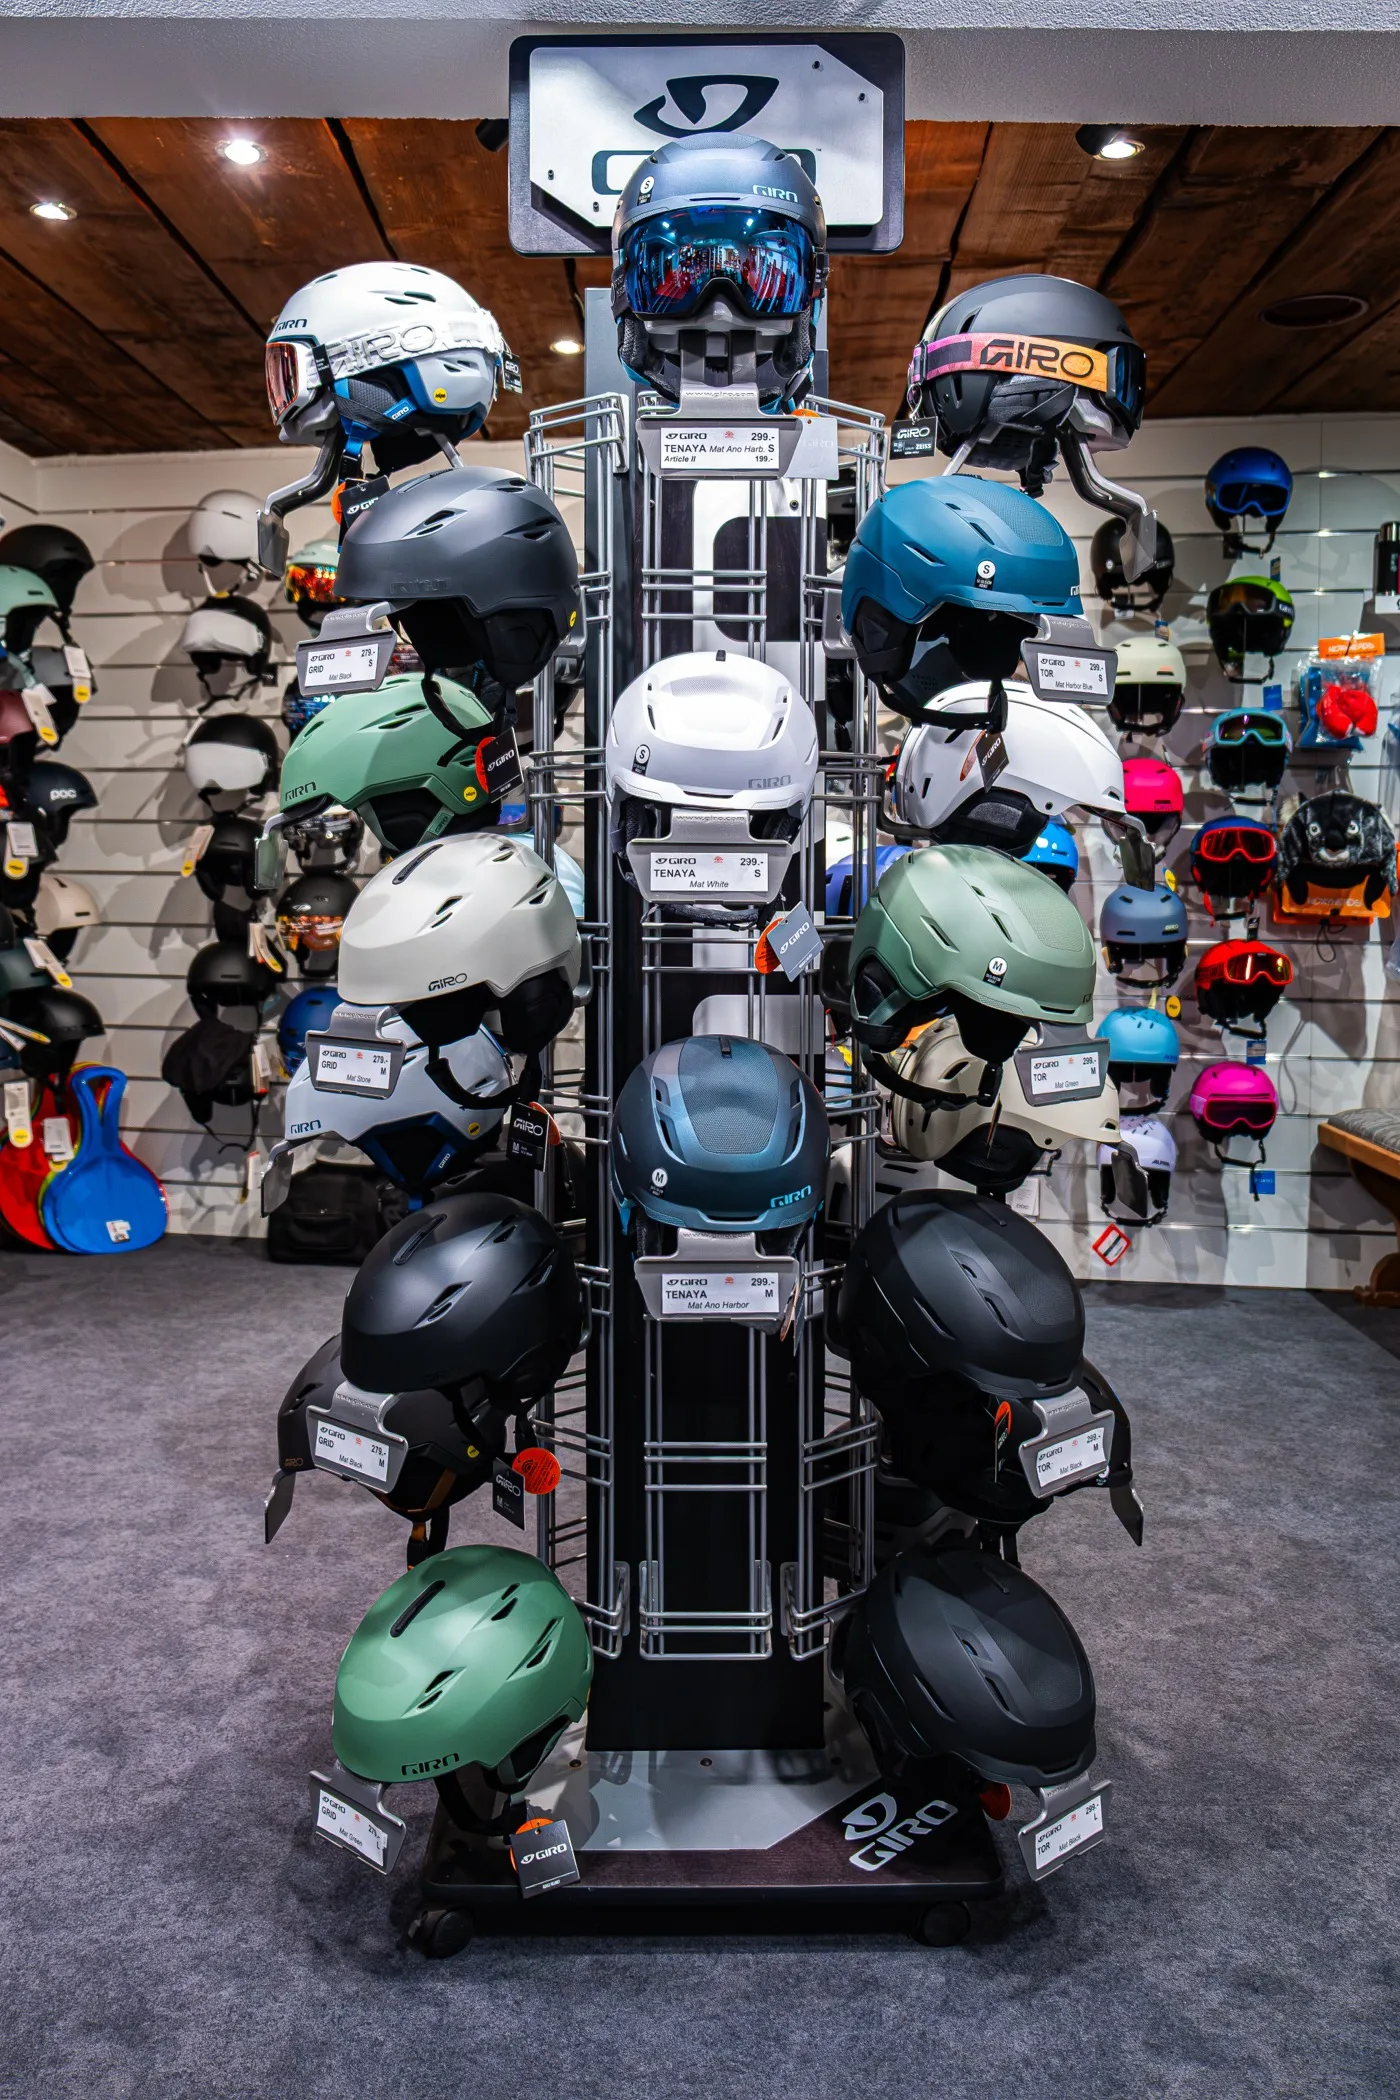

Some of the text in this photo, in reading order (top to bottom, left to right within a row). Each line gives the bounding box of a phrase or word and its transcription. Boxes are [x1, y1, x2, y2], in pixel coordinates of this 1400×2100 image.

[752, 184, 798, 203] GIRO
[275, 318, 307, 332] GIRO
[979, 338, 1095, 379] GIRO
[391, 406, 410, 421] GIRO
[679, 432, 775, 442] GIRO 299.-
[896, 427, 931, 440] GIRO
[664, 444, 775, 453] TENAYA Mat Ano Harb. S
[915, 442, 932, 450] ZEISS
[664, 455, 689, 463] Article
[755, 455, 774, 463] 199.-
[318, 649, 376, 662] GIRO 279.-
[308, 665, 323, 674] GRID
[1040, 668, 1054, 678] TOR
[1090, 663, 1104, 671] 299.-
[1066, 682, 1082, 690] Harbor
[1083, 682, 1093, 690] Blue
[495, 749, 515, 767] GIRO
[748, 775, 791, 788] GIRO
[285, 781, 317, 801] GIRO
[669, 857, 764, 866] GIRO 299.-
[654, 869, 761, 878] TENAYA S
[789, 921, 810, 946] GIRO
[992, 961, 1003, 972] M
[428, 972, 468, 992] GIRO
[330, 1051, 388, 1064] GIRO 279.-
[1043, 1057, 1097, 1068] GIRO 299.-
[322, 1061, 387, 1075] GRID M
[1033, 1067, 1096, 1081] TOR M
[346, 1074, 372, 1084] Mat Stone
[1065, 1080, 1079, 1088] Green
[290, 1120, 322, 1134] GIRO
[513, 1118, 544, 1136] GIRO
[655, 1172, 664, 1184] M
[770, 1184, 812, 1209] GIRO
[680, 1278, 775, 1286] GIRO 299.-
[666, 1289, 773, 1299] TENAYA M
[705, 1301, 720, 1309] Ano
[722, 1301, 749, 1309] Harbor
[328, 1429, 387, 1457] GIRO 279.-
[1046, 1433, 1101, 1459] GIRO 299.-
[318, 1436, 385, 1468] GRID M
[1038, 1443, 1099, 1473] TOR M
[339, 1454, 363, 1469] Mat Black
[1059, 1461, 1083, 1475] Mat Black
[496, 1474, 521, 1497] GIRO
[401, 1752, 460, 1776] GIRO
[321, 1806, 337, 1821] GRID
[329, 1800, 346, 1814] GIRO
[1045, 1803, 1100, 1838] GIRO 299.-
[340, 1827, 363, 1847] Mat Green
[849, 1800, 959, 1872] GIRO
[1037, 1842, 1051, 1855] TOR
[1059, 1834, 1082, 1853] Mat Black
[535, 1843, 568, 1860] GIRO
